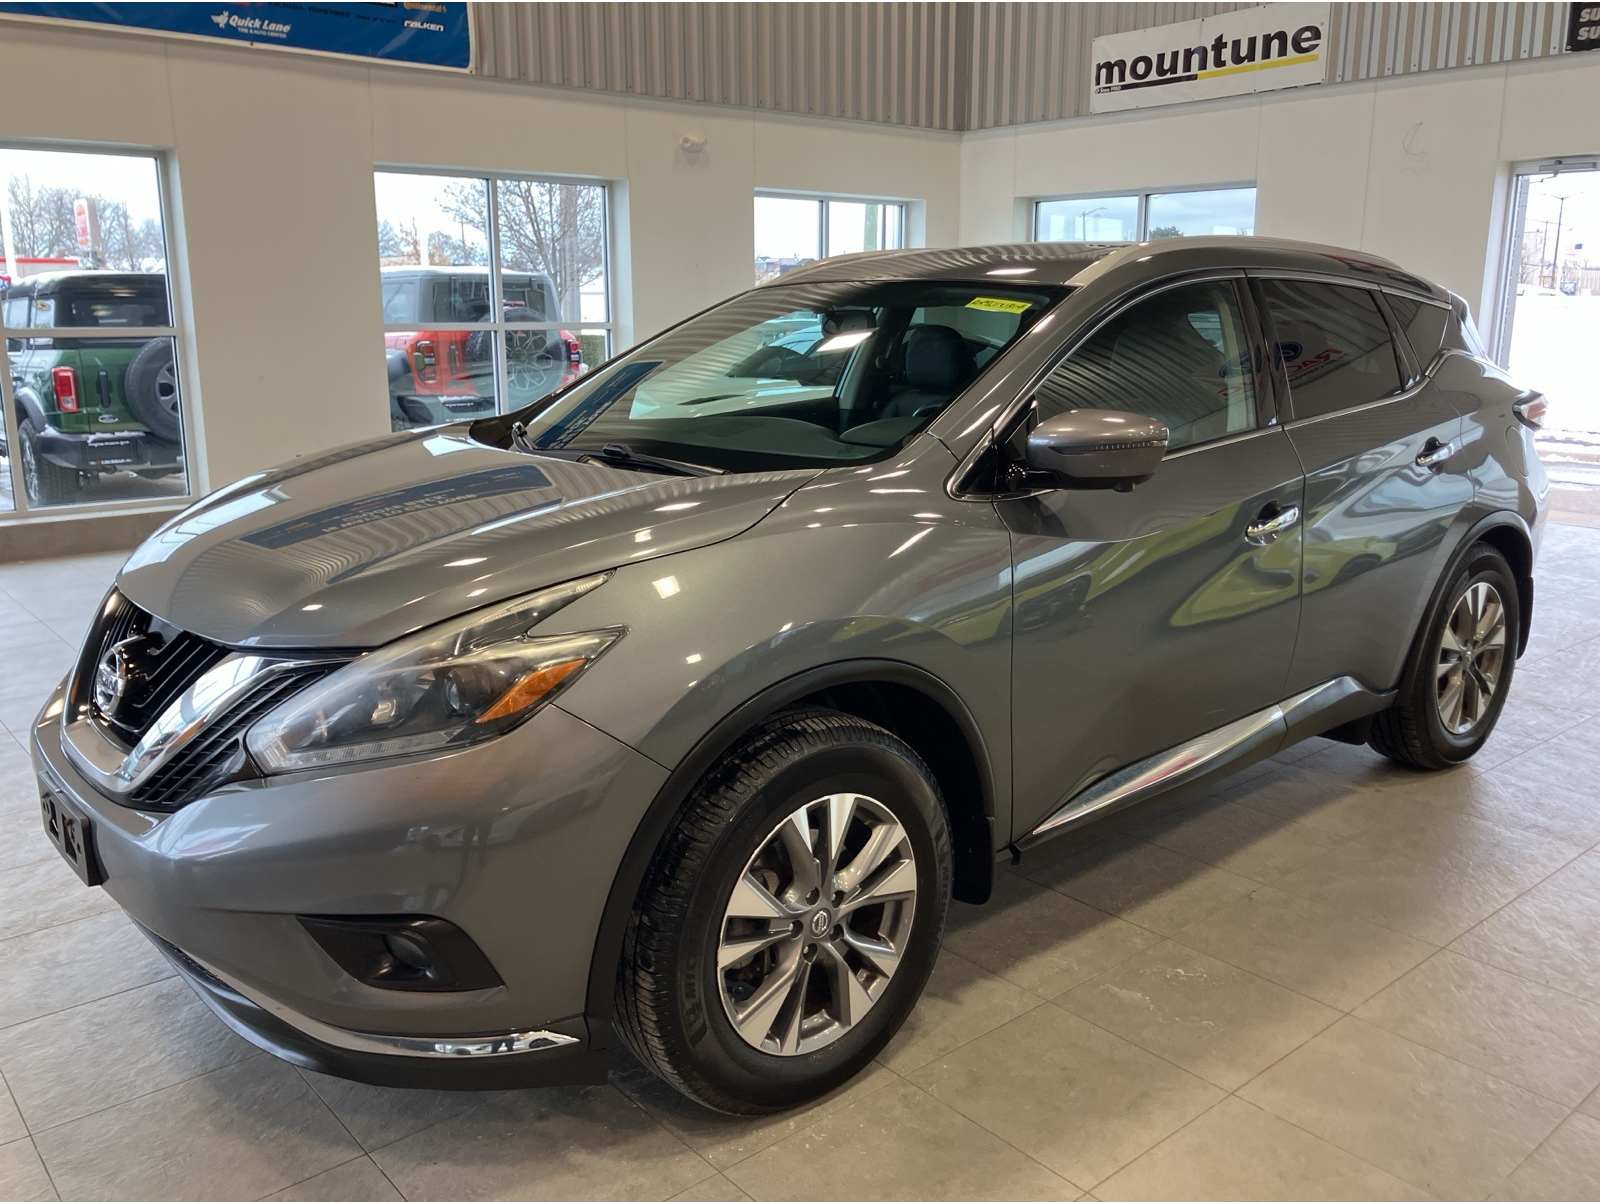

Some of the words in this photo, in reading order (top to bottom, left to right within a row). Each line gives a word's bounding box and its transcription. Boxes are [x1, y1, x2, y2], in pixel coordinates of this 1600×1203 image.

[229, 14, 261, 29] Quick
[262, 20, 292, 33] Lane
[1095, 25, 1322, 86] mountune
